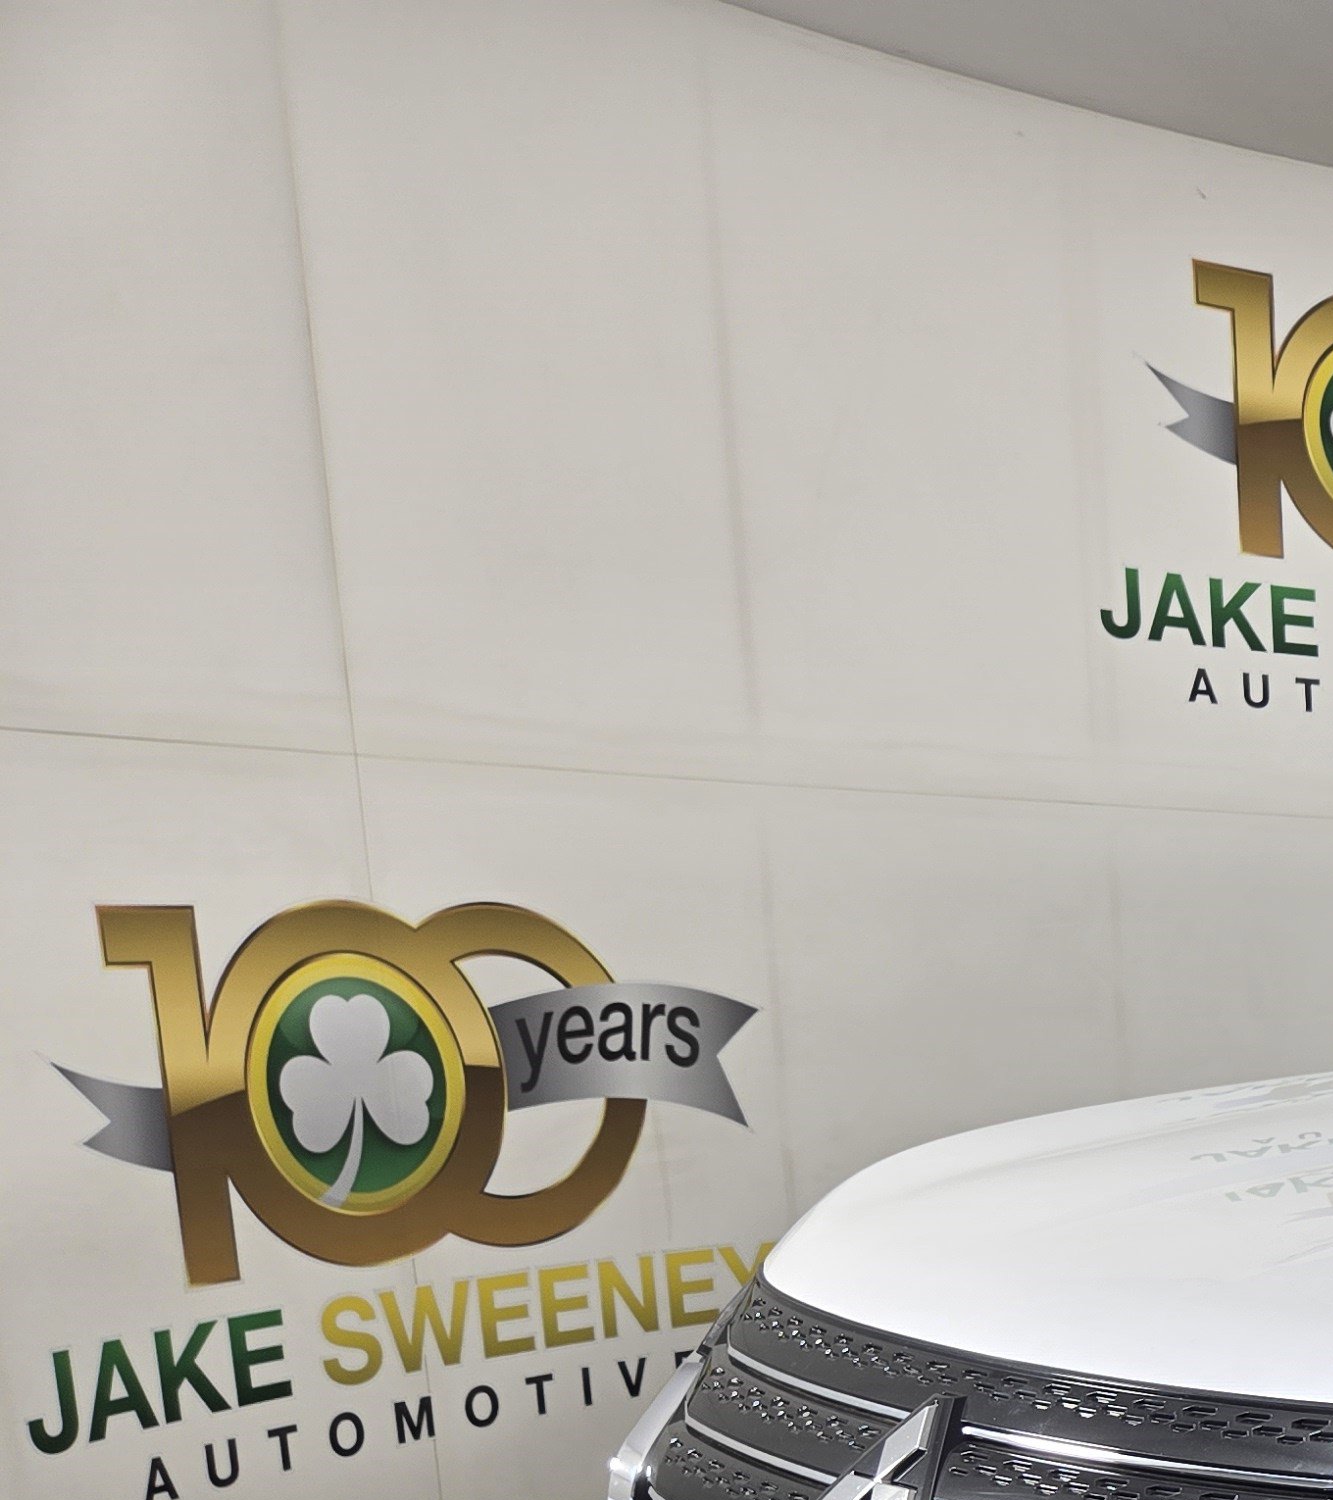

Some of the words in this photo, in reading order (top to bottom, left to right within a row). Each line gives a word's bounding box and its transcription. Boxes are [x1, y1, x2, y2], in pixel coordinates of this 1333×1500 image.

[1099, 566, 1320, 658] JAKE
[516, 1001, 701, 1093] years
[28, 1309, 293, 1455] JAKE
